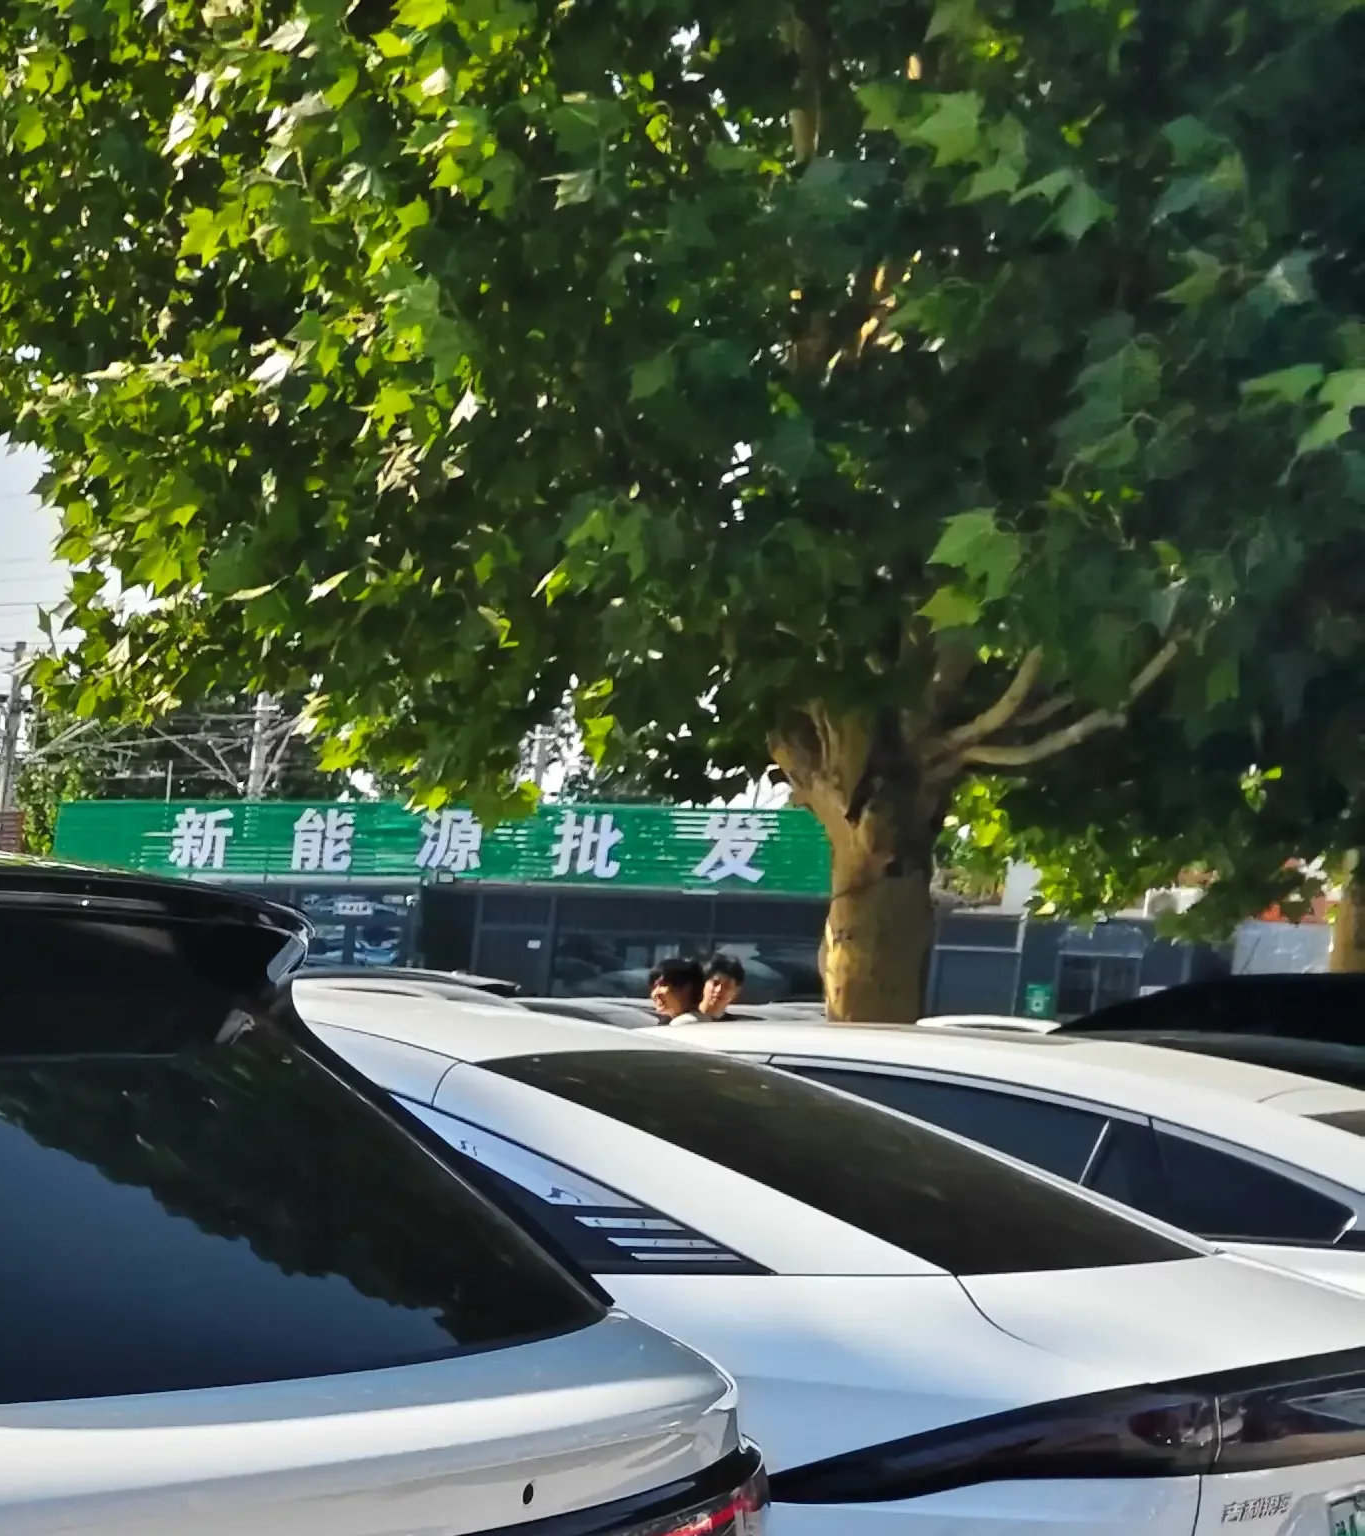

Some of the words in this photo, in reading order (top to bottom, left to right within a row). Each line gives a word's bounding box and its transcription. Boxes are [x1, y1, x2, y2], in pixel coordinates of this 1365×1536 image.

[170, 808, 770, 883] 新能源批发
